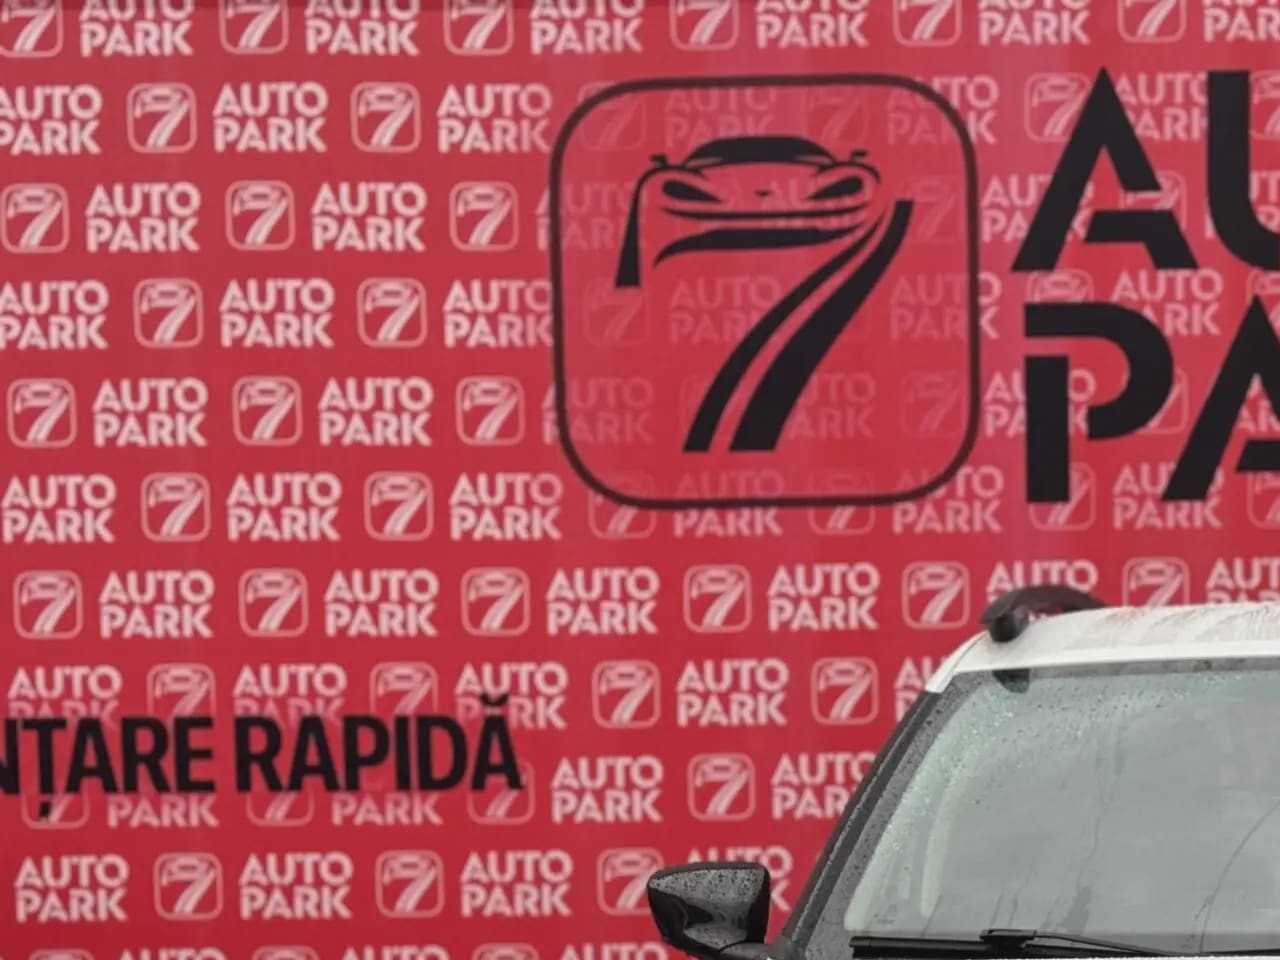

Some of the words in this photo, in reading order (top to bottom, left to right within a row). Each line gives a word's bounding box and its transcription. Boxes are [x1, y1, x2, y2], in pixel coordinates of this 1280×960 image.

[79, 21, 191, 57] PARK
[305, 20, 417, 56] PARK
[530, 19, 642, 55] PARK
[755, 12, 867, 48] PARK
[978, 10, 1090, 46] PARK
[213, 82, 328, 118] AUTO
[437, 83, 552, 119] AUTO
[213, 116, 325, 152] PARK
[437, 117, 549, 153] PARK
[86, 182, 201, 218] AUTO
[311, 181, 426, 217] AUTO
[86, 216, 198, 252] PARK
[311, 215, 423, 251] PARK
[0, 280, 109, 316] AUTO
[220, 278, 335, 314] AUTO
[443, 278, 558, 314] AUTO
[1110, 267, 1225, 303] AUTO
[0, 314, 106, 350] PARK
[220, 312, 332, 348] PARK
[443, 312, 555, 348] PARK
[93, 377, 208, 413] AUTO
[318, 376, 433, 412] AUTO
[93, 411, 205, 447] PARK
[318, 410, 430, 446] PARK
[1, 474, 116, 510] AUTO
[227, 472, 342, 508] AUTO
[449, 471, 564, 507] AUTO
[1, 508, 113, 544] PARK
[227, 506, 339, 542] PARK
[449, 505, 561, 541] PARK
[890, 499, 1002, 535] PARK
[1111, 495, 1223, 531] PARK
[99, 569, 214, 605] AUTO
[324, 568, 439, 604] AUTO
[545, 566, 660, 602] AUTO
[766, 562, 881, 598] AUTO
[99, 603, 211, 639] PARK
[324, 602, 436, 638] PARK
[545, 600, 657, 636] PARK
[766, 596, 878, 632] PARK
[7, 664, 122, 700] AUTO
[232, 662, 347, 698] AUTO
[454, 661, 569, 697] AUTO
[675, 658, 790, 694] AUTO
[675, 692, 787, 728] PARK
[234, 692, 523, 793] RAPIDĂ
[550, 754, 665, 790] AUTO
[106, 793, 218, 829] PARK
[330, 791, 442, 827] PARK
[550, 788, 662, 824] PARK
[14, 853, 129, 889] AUTO
[239, 851, 354, 887] AUTO
[459, 848, 574, 884] AUTO
[14, 887, 126, 923] PARK
[239, 885, 351, 921] PARK
[459, 882, 571, 918] PARK
